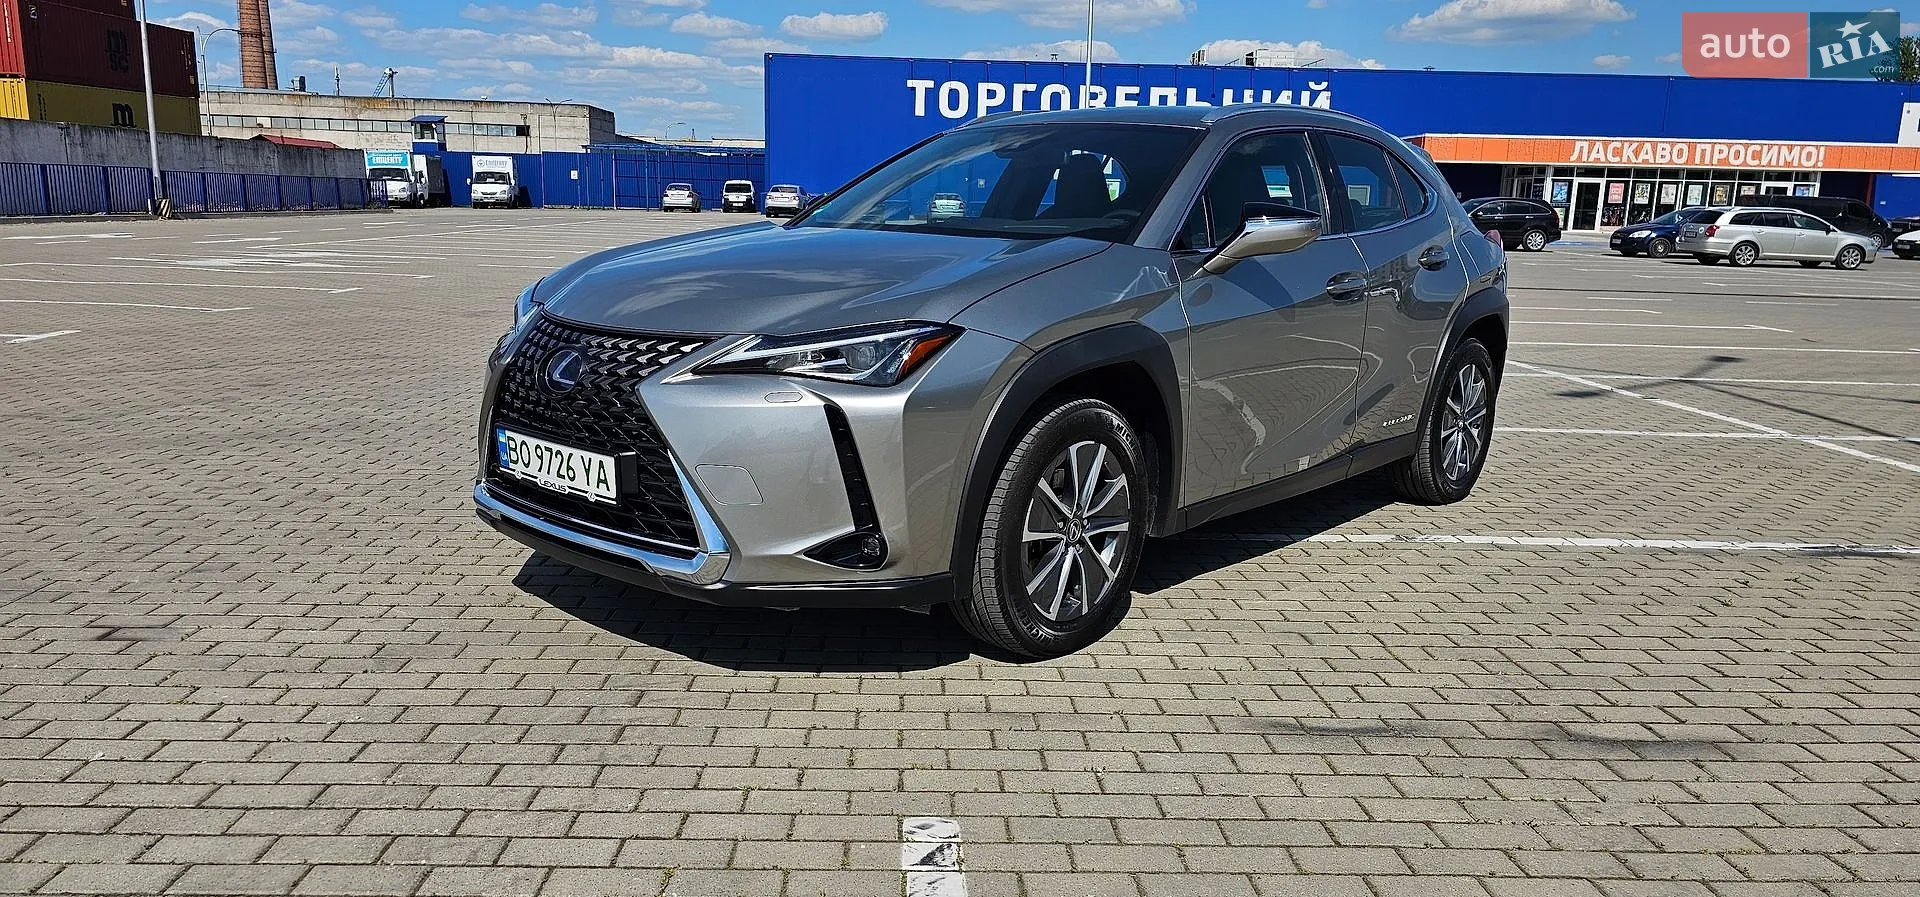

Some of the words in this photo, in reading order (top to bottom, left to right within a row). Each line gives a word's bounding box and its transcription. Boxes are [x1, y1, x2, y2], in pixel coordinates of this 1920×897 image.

[1570, 140, 1688, 164] ЛАСКАВО
[1694, 143, 1825, 167] ПРОСИМО!
[507, 436, 531, 468] BO
[534, 444, 576, 482] 9726
[580, 455, 610, 492] YA
[539, 479, 567, 492] LEXUS
